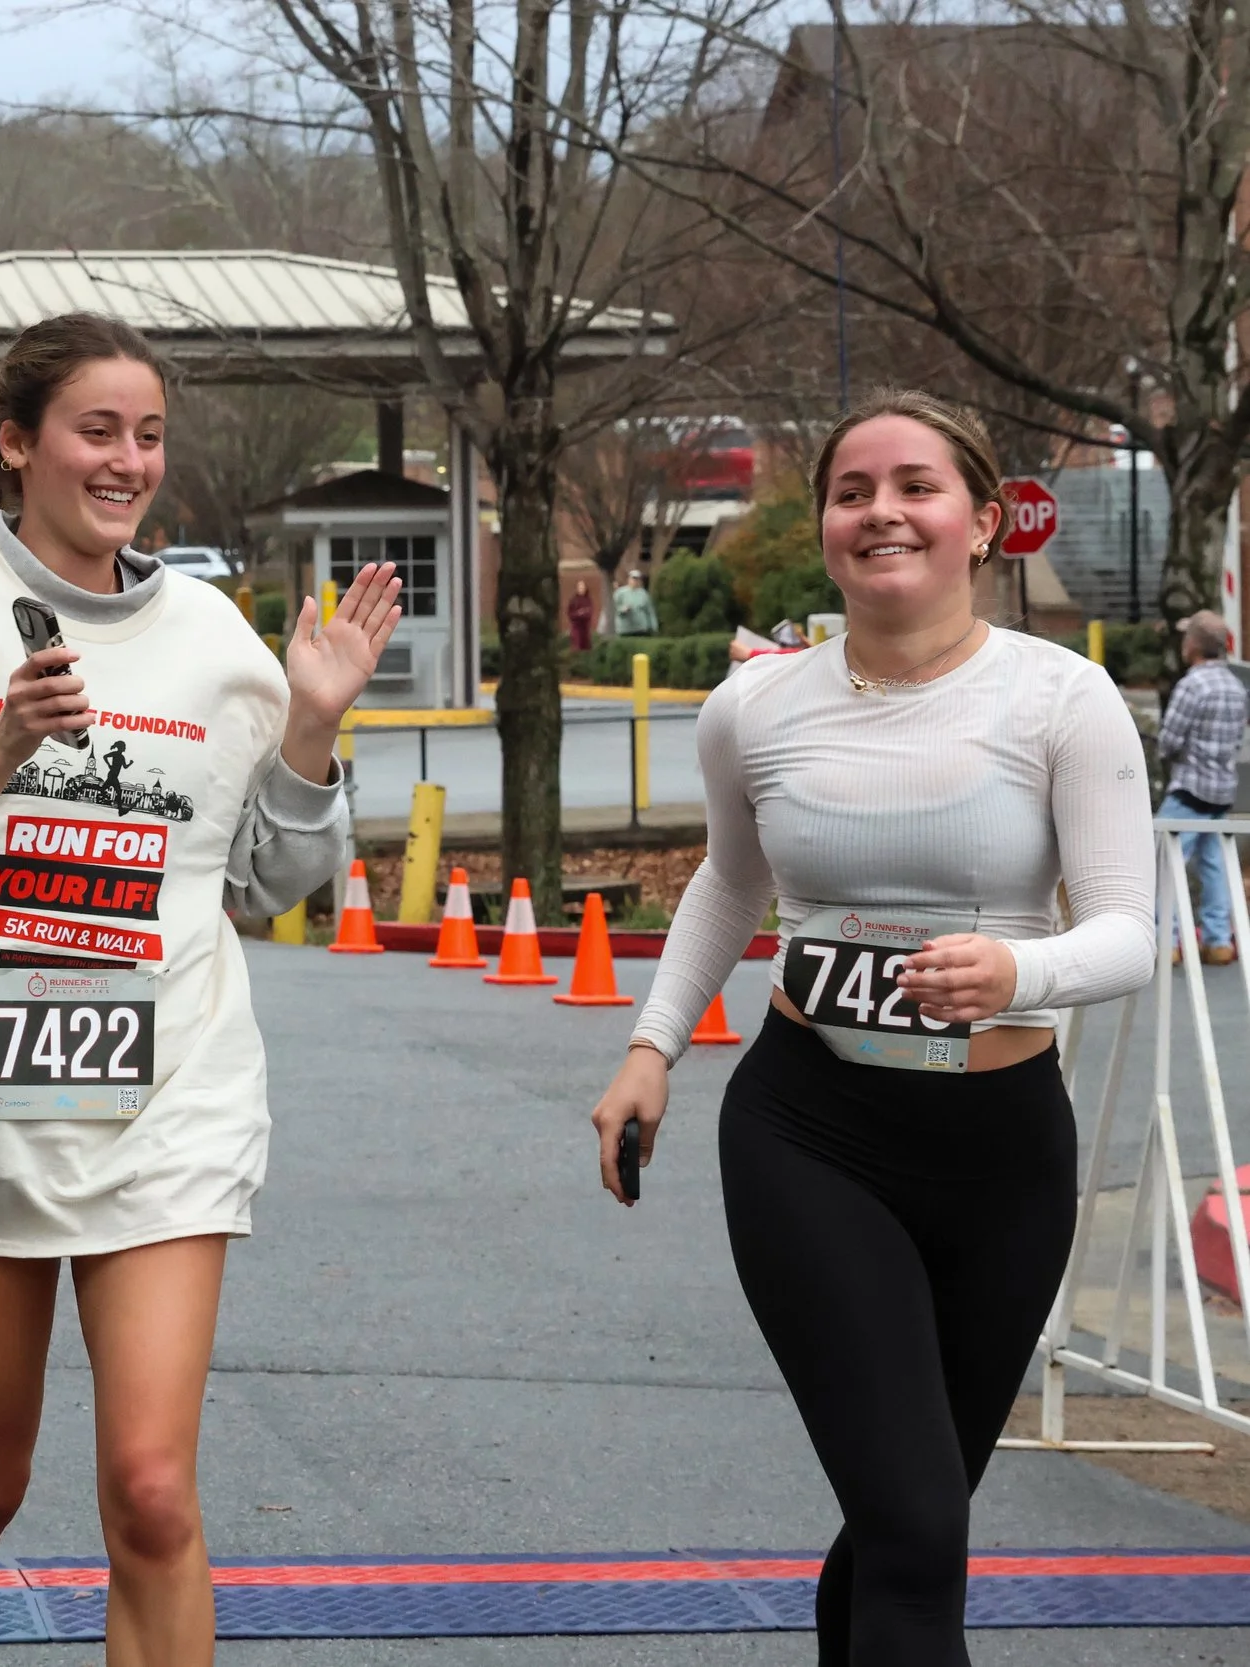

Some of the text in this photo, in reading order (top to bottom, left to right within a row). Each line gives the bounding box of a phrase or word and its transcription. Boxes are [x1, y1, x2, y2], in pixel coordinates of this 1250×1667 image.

[100, 711, 207, 743] FOUNDATION
[1117, 765, 1135, 780] alo
[9, 822, 164, 863] RUN FOR
[91, 878, 159, 912] LIFE
[4, 917, 147, 955] 5K RUN & WALK
[864, 931, 921, 941] RACEWORK
[865, 921, 930, 936] RUNNERS FIT
[803, 944, 950, 1031] 742
